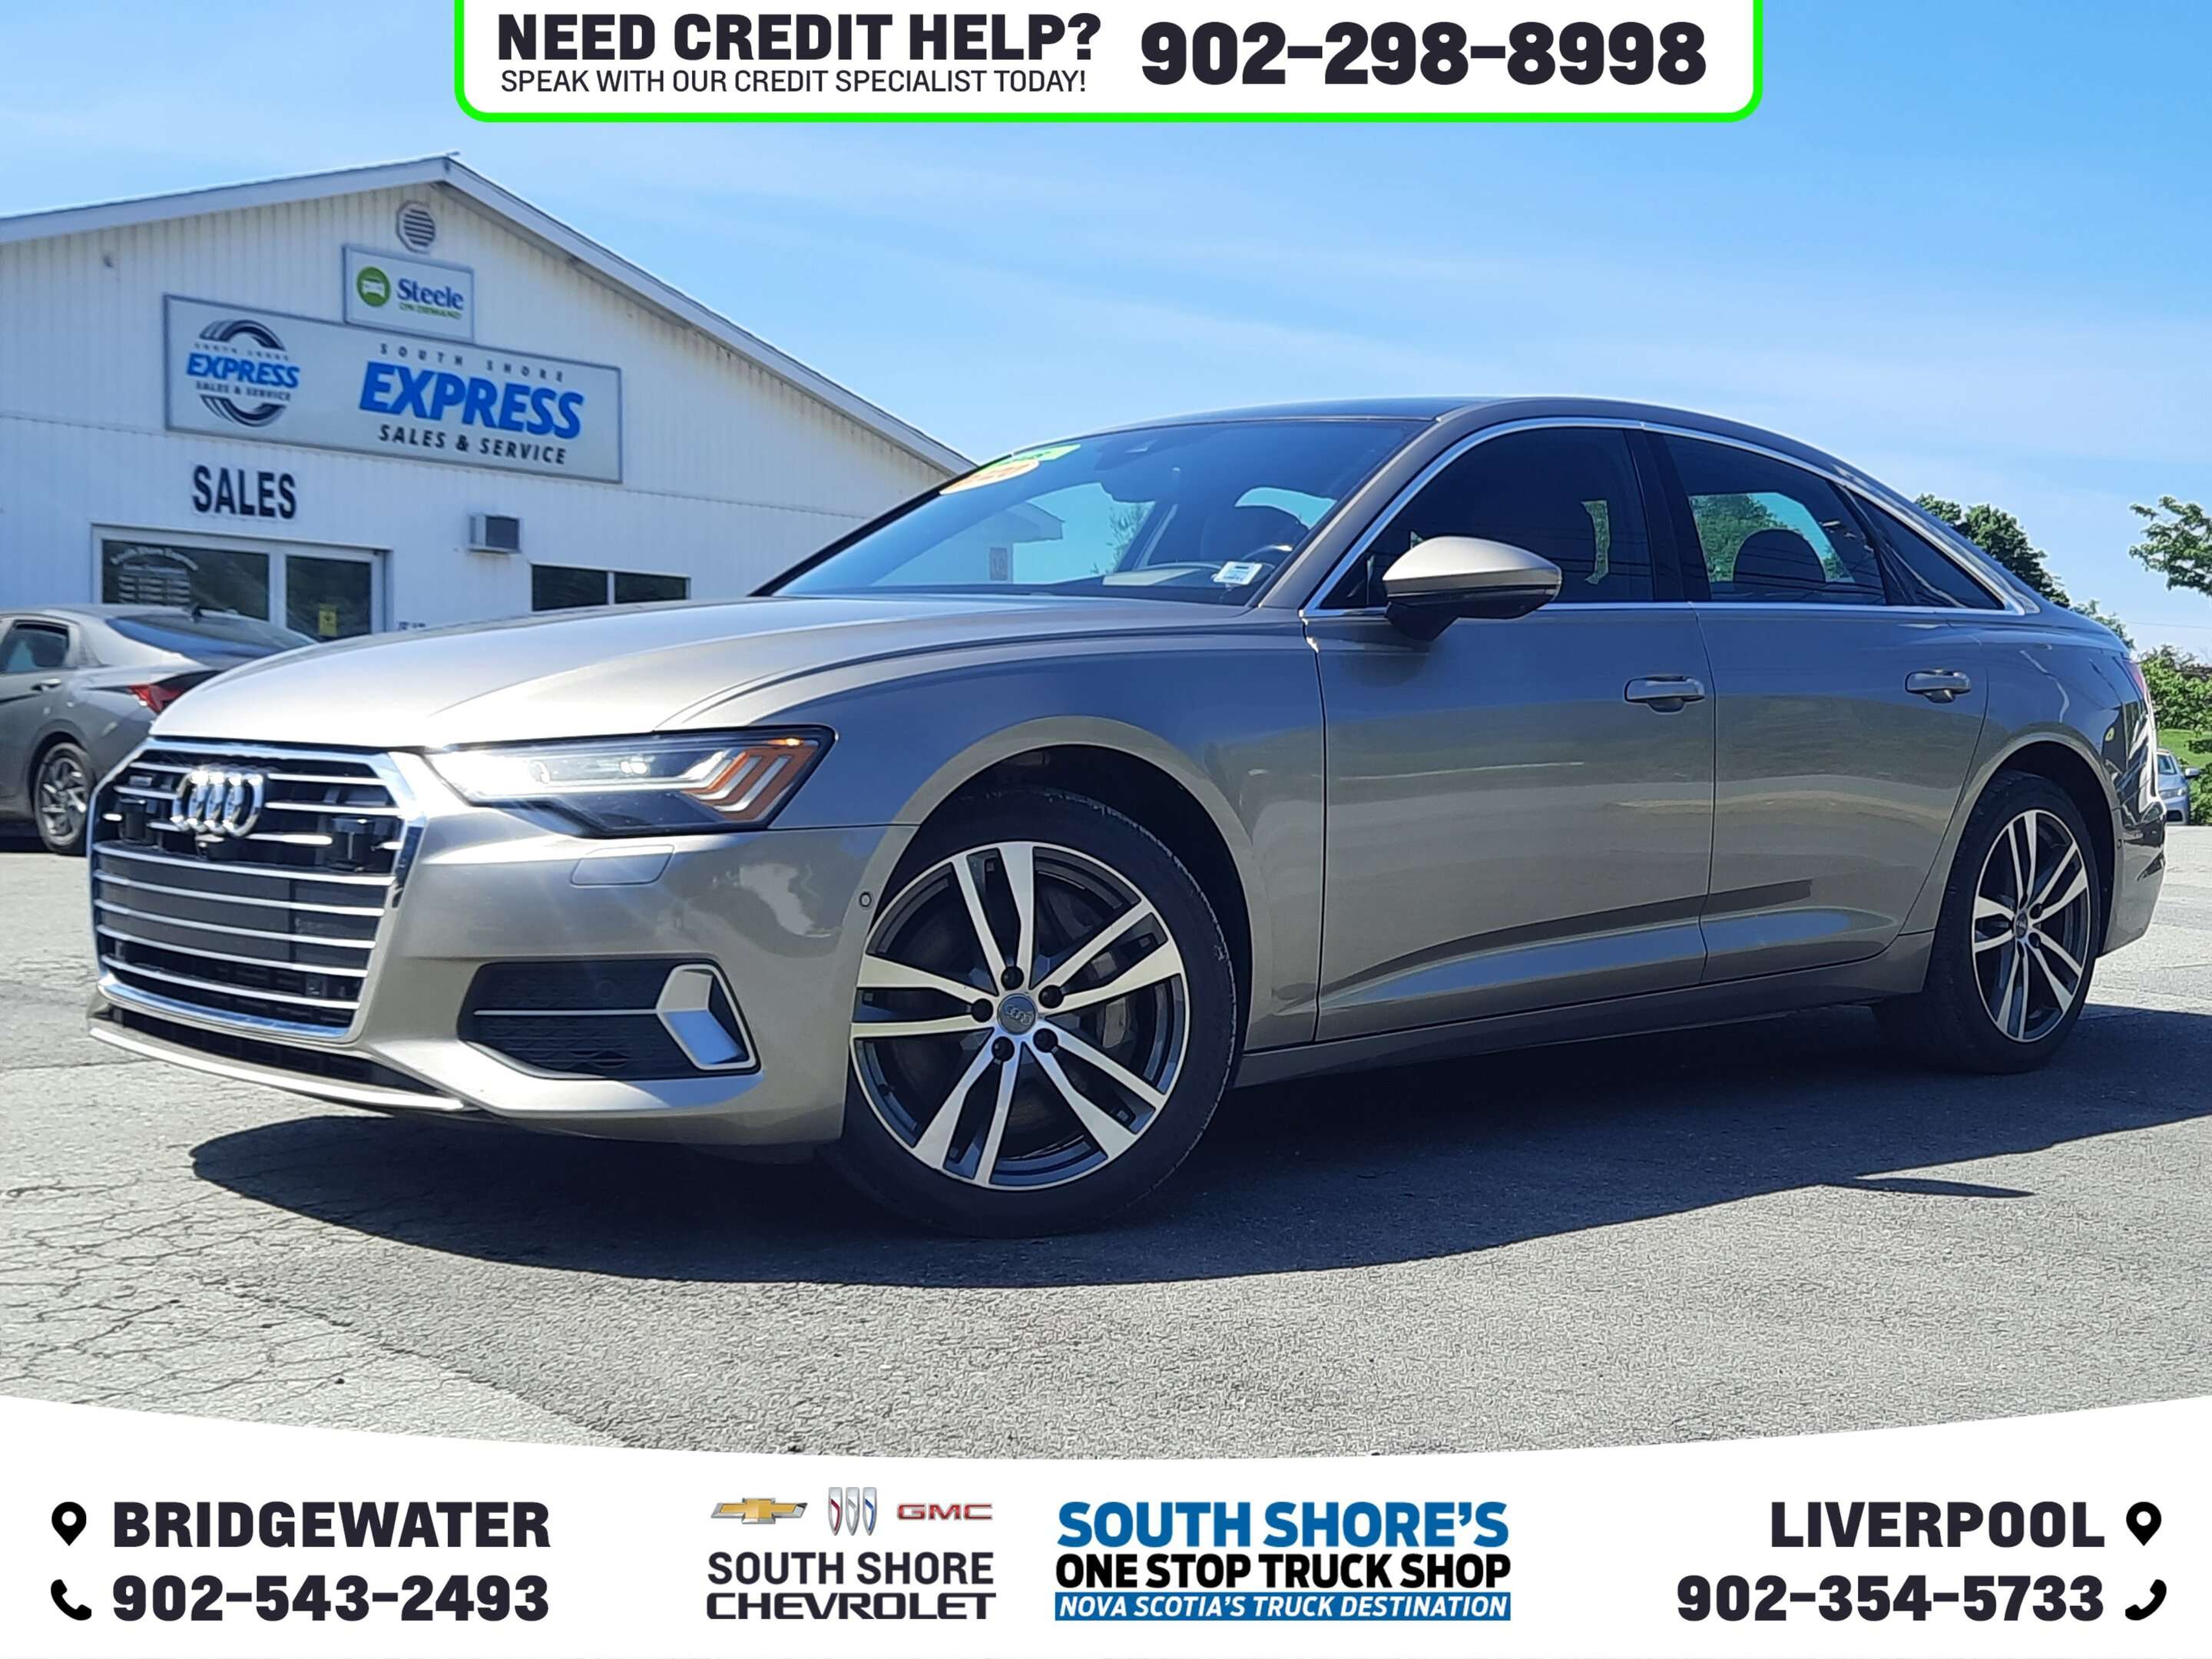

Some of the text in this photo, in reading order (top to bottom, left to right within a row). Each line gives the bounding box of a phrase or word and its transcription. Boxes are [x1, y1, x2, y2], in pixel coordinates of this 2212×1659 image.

[397, 278, 464, 310] Steele
[187, 353, 300, 389] EXPRESS
[379, 343, 563, 382] SOUTH SHORE
[359, 361, 584, 439] EXPRESS
[378, 424, 567, 465] SALES & SERVICE
[192, 464, 297, 520] SALES
